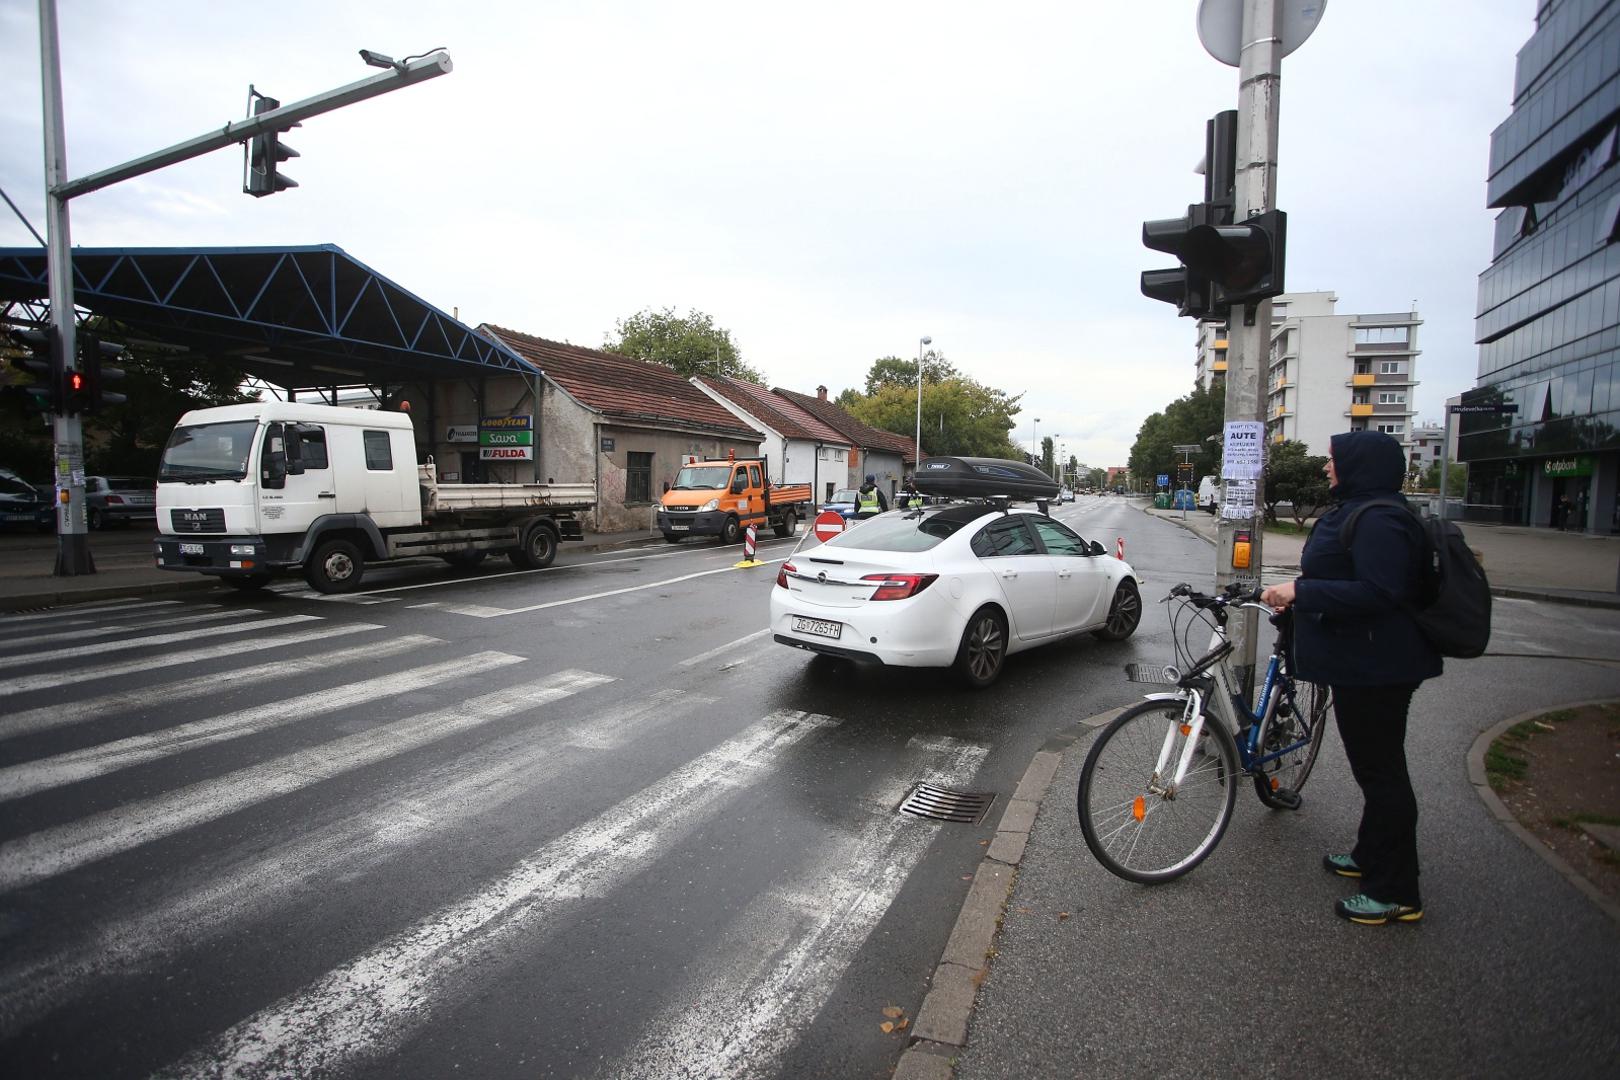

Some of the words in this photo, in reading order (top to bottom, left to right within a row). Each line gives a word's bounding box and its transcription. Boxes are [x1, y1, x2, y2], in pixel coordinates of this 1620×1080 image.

[481, 416, 528, 427] GOODYEAR
[489, 433, 518, 443] Sava
[1230, 432, 1257, 440] AUTE
[492, 449, 526, 458] FULDA
[183, 513, 207, 521] MAN
